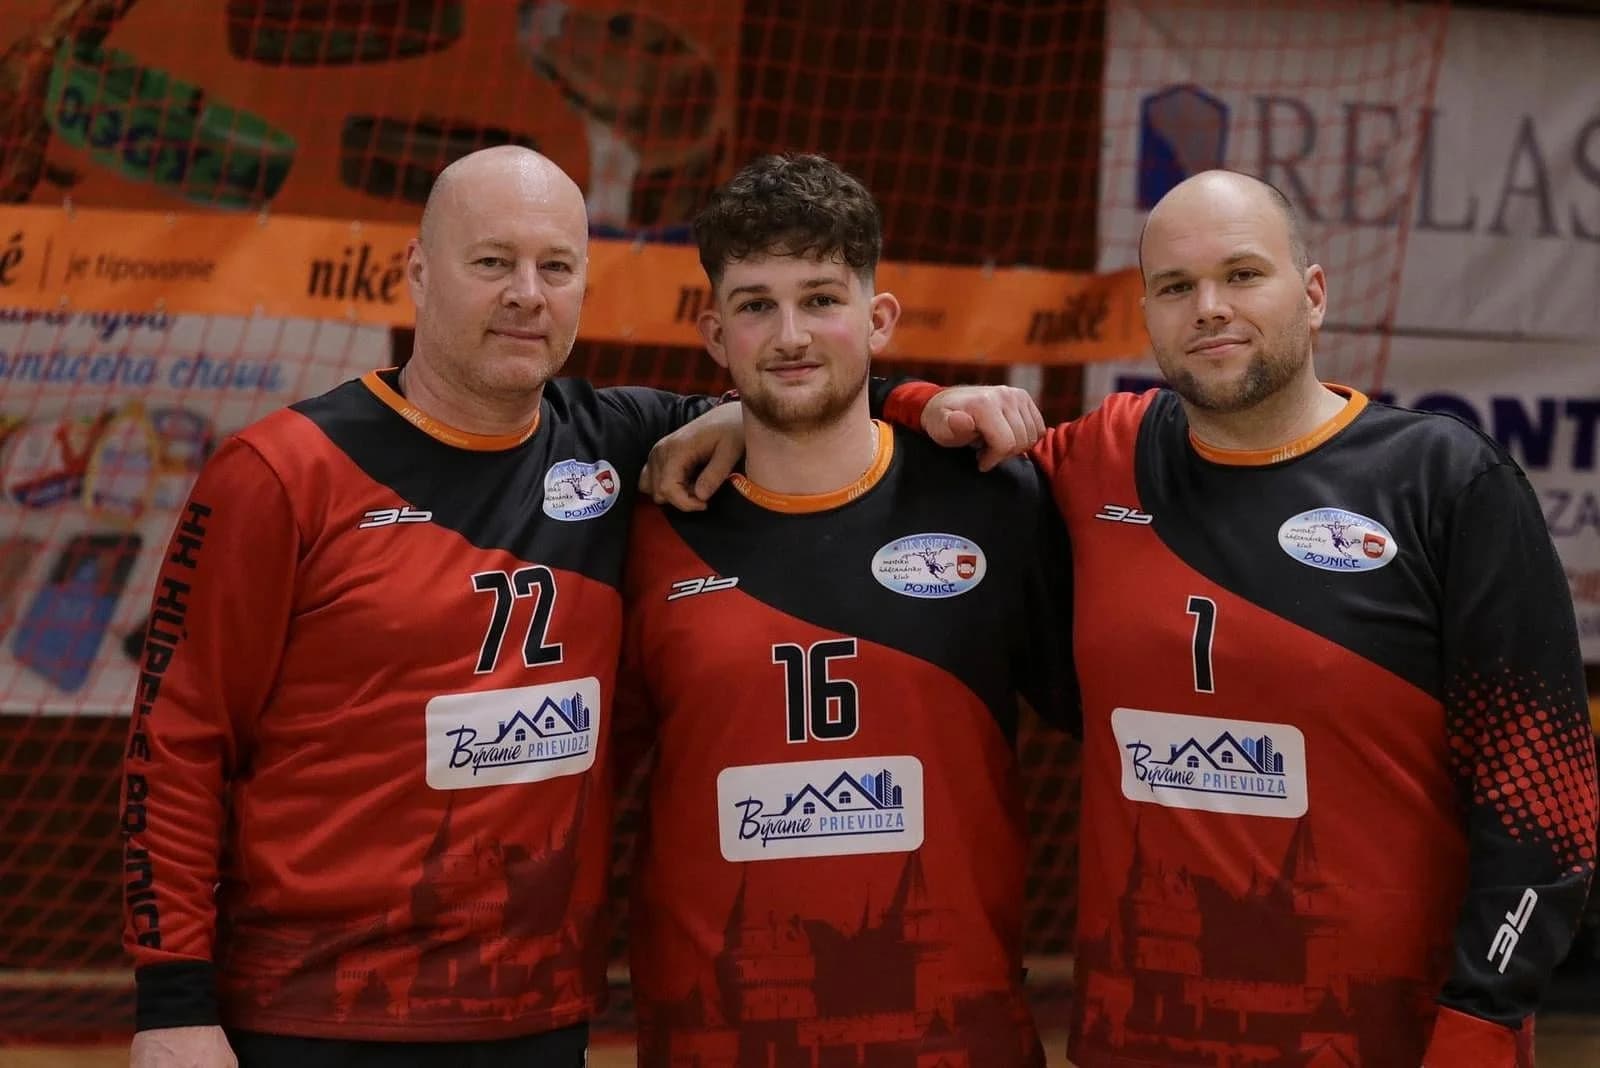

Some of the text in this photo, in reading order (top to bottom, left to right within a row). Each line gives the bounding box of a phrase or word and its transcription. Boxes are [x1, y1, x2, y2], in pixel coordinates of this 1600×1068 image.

[307, 241, 405, 305] niké
[903, 582, 958, 594] BOJNICE
[1304, 551, 1361, 569] BOJNICE
[470, 564, 564, 675] 72
[1185, 594, 1217, 694] 1
[771, 636, 859, 745] 16
[446, 724, 590, 777] Bývanie PRIEVIDZA
[1125, 739, 1287, 795] Bývanie PRIEVIDZA
[734, 795, 905, 848] Bývanie PRIEVIDZA
